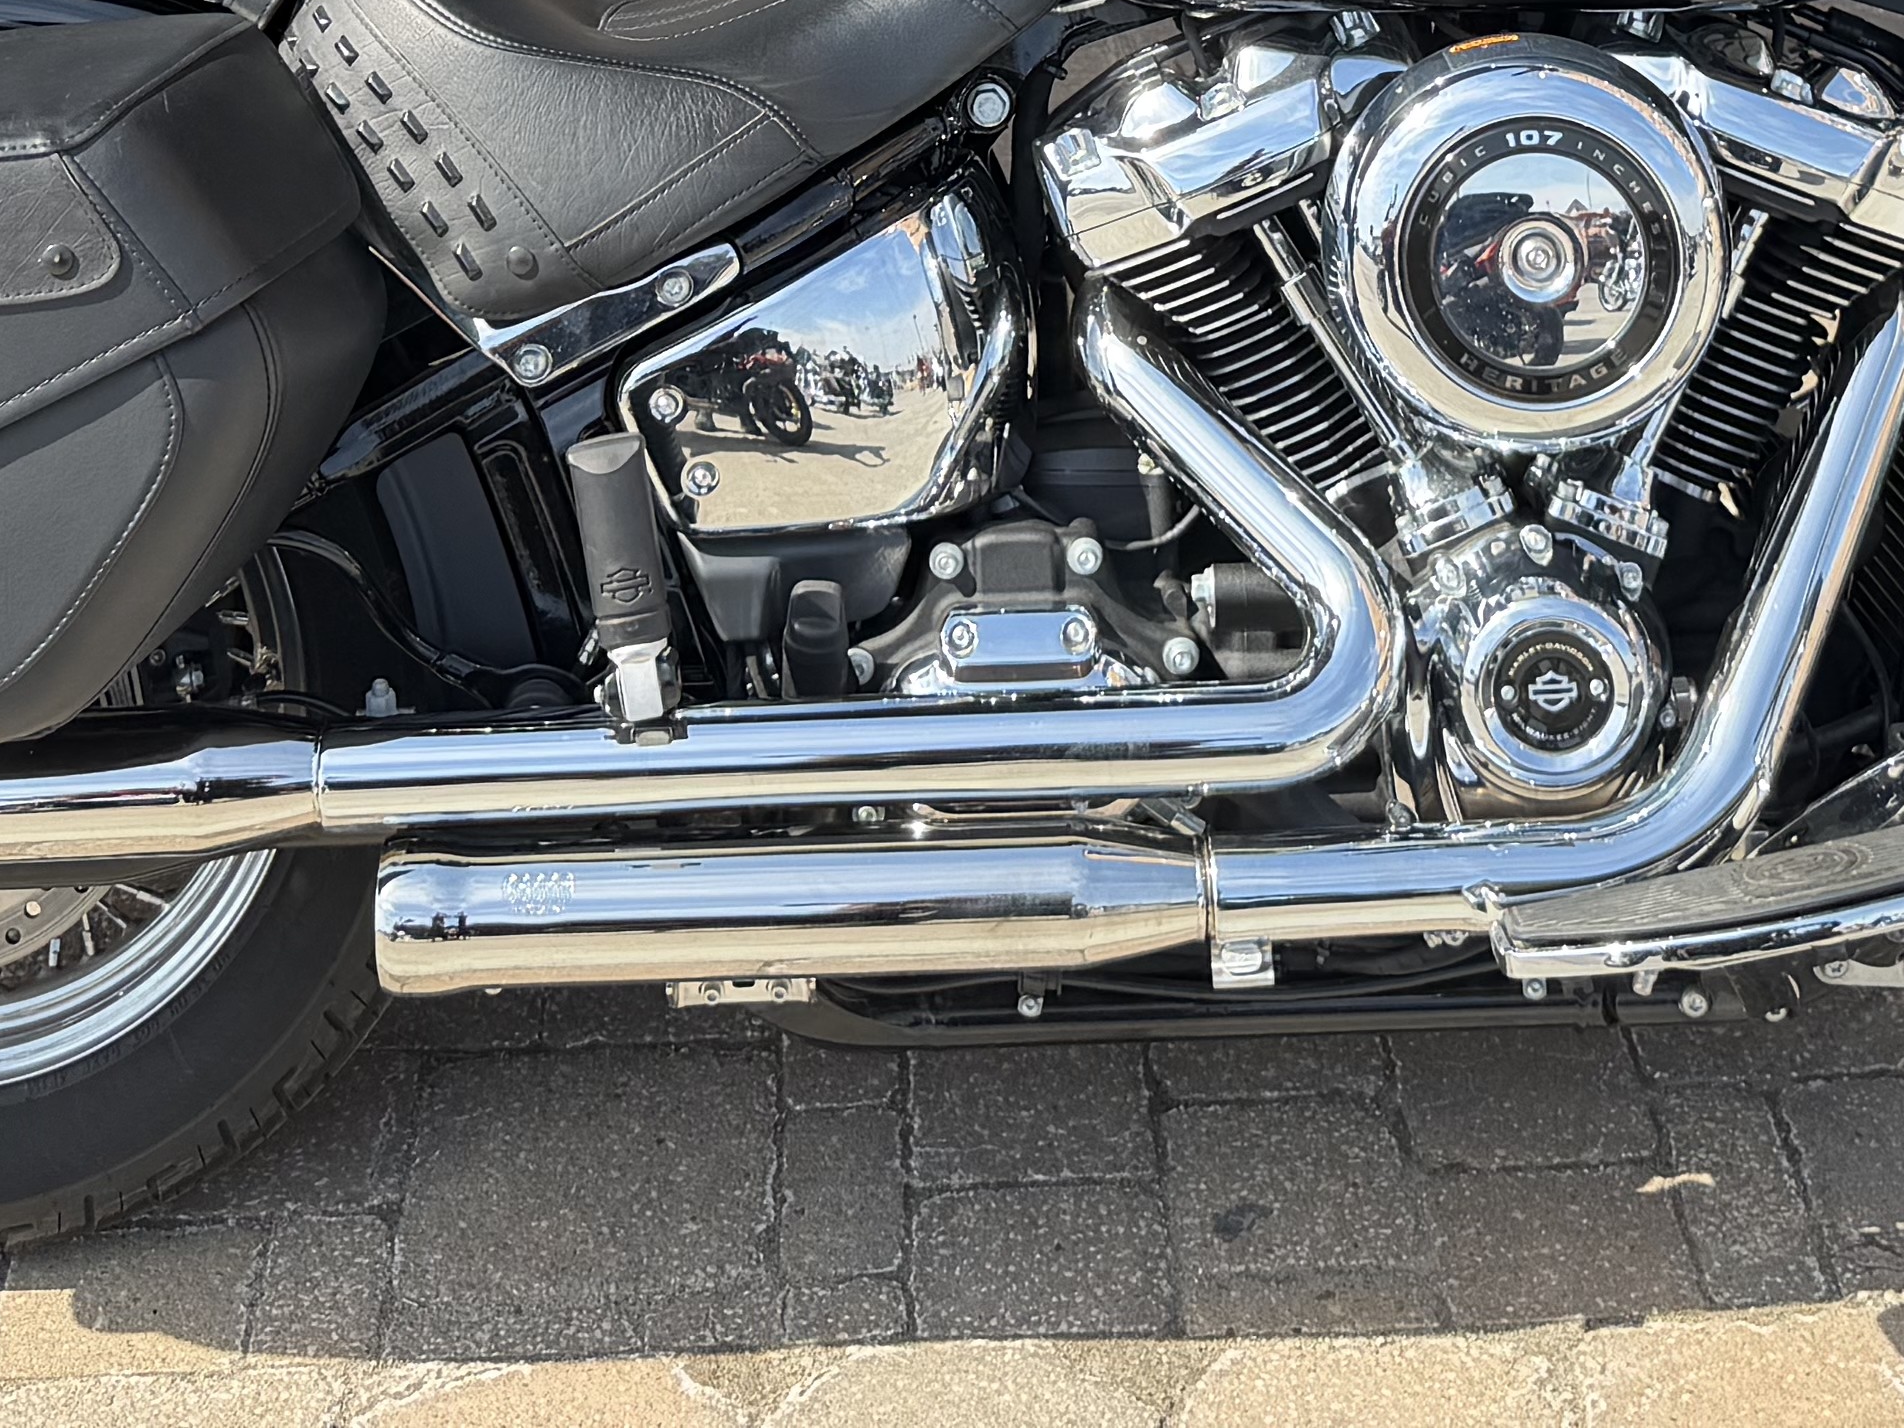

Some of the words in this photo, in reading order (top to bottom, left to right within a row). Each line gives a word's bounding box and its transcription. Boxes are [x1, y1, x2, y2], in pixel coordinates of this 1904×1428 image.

[1419, 146, 1487, 225] CUBIC
[1505, 130, 1563, 148] 107
[1577, 141, 1662, 235] INCHES
[1460, 348, 1630, 393] HERITAGE
[1508, 642, 1594, 677] HARLEY-DAVIDSON
